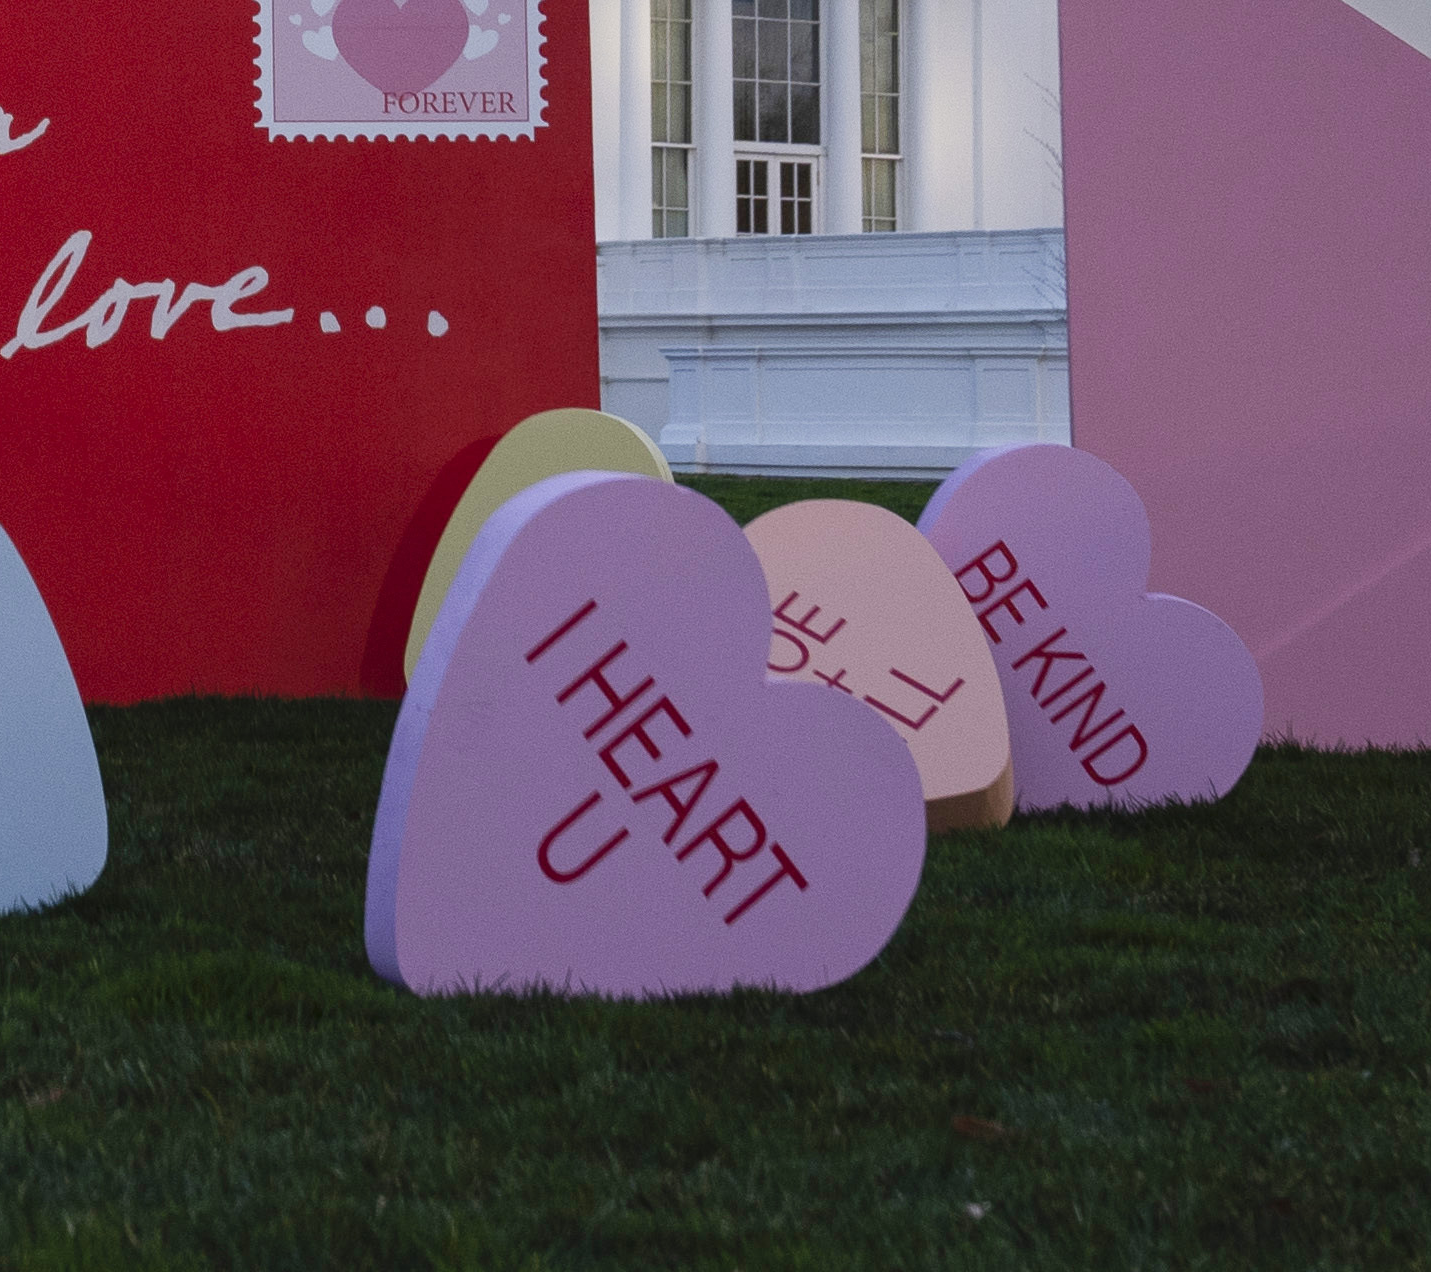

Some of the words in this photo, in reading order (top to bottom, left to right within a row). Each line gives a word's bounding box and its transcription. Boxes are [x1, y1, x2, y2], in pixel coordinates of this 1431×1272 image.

[382, 91, 517, 115] FOREVER
[526, 598, 597, 664] I
[954, 539, 1050, 645] BE
[1011, 625, 1149, 787] KIND
[556, 639, 809, 926] HEART
[537, 790, 631, 885] U
